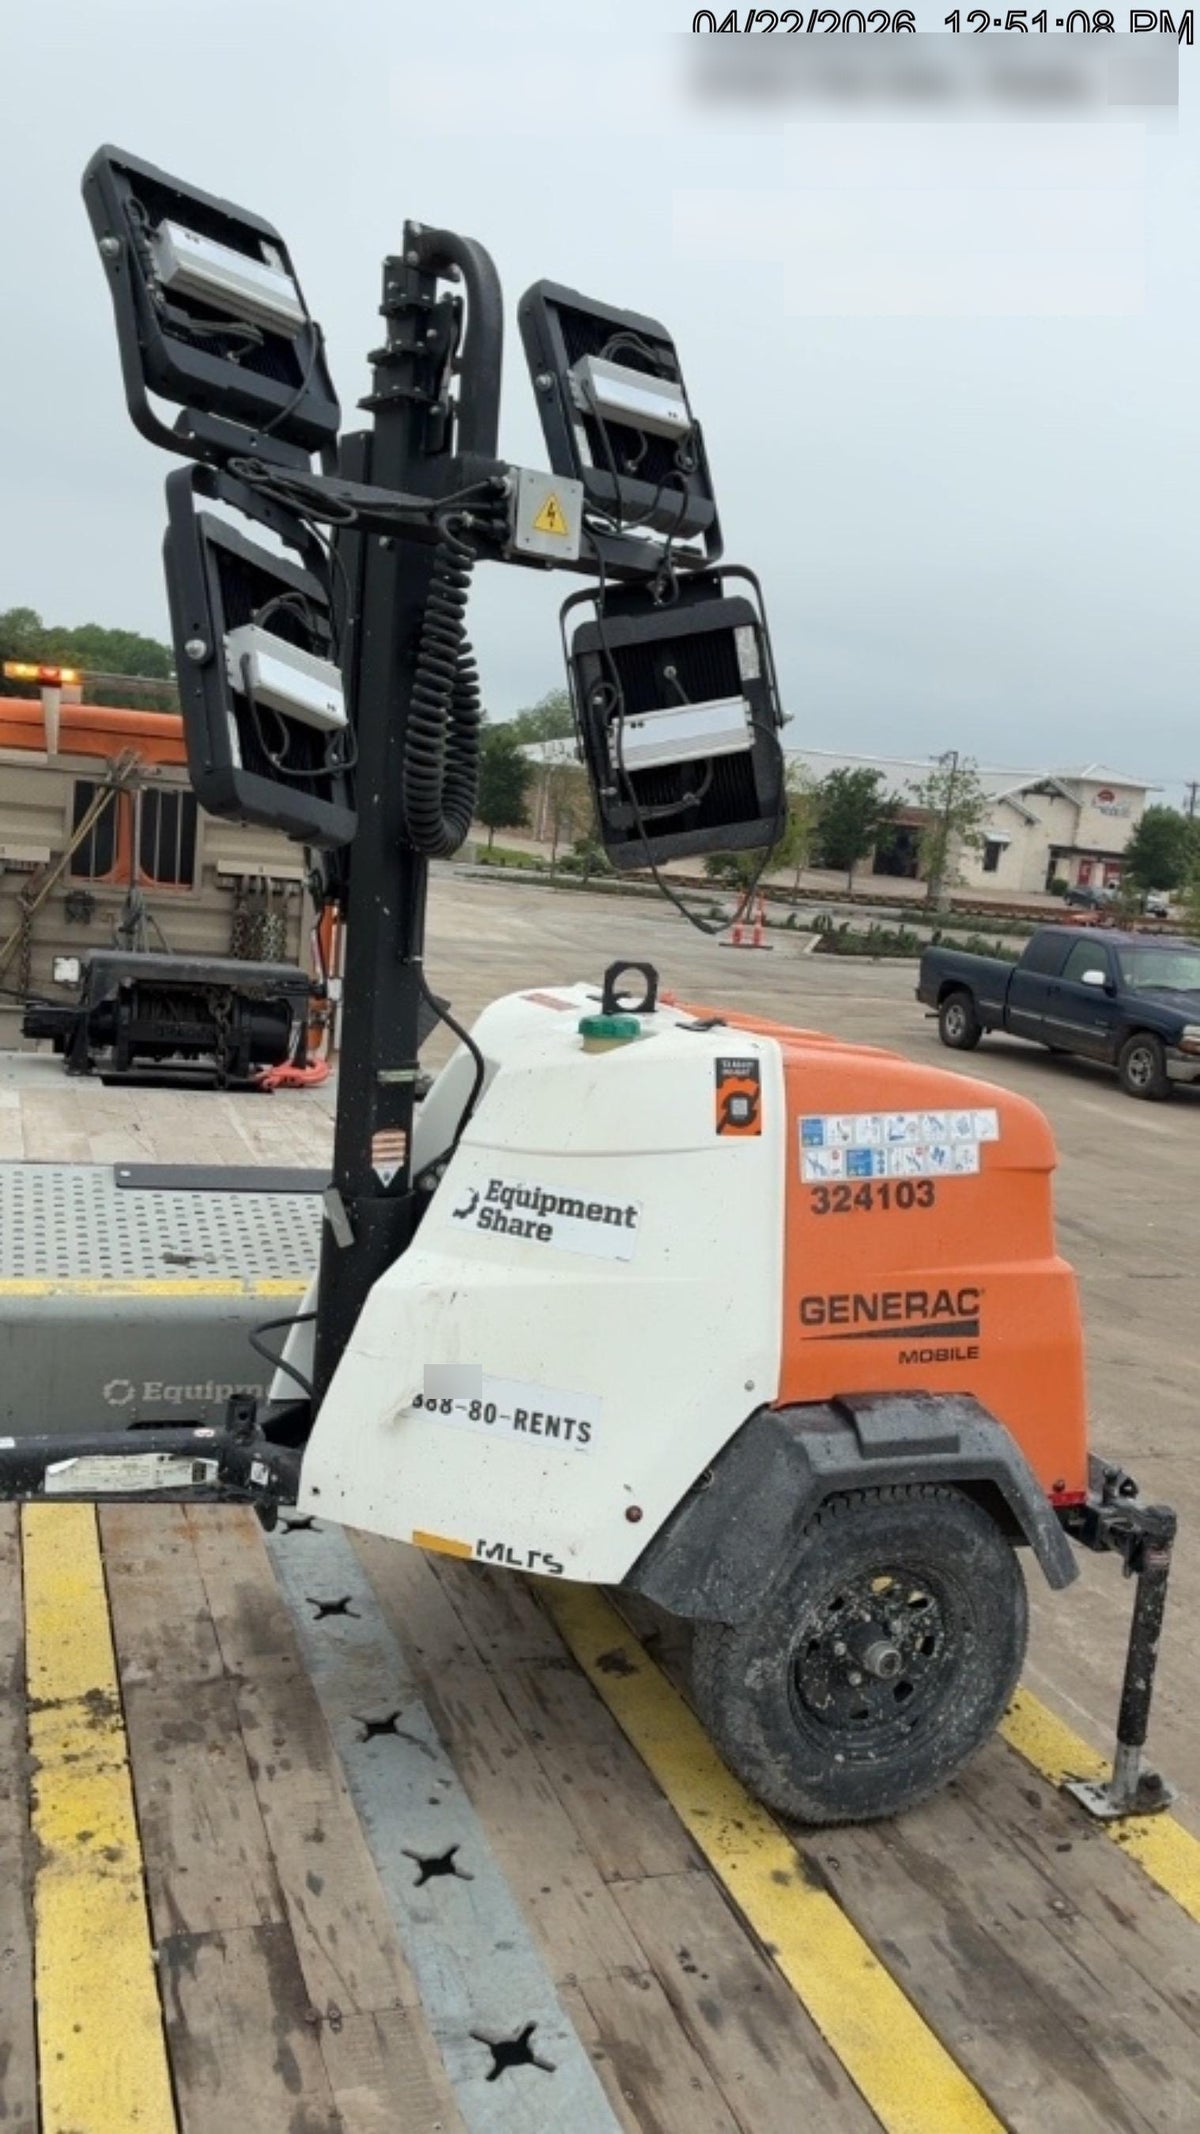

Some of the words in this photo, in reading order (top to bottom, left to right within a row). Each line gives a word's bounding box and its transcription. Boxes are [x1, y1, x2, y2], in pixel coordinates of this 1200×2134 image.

[484, 1178, 637, 1229] Equipment
[810, 1180, 935, 1215] 324103
[476, 1206, 554, 1242] Share
[800, 1287, 980, 1326] GENERAC
[897, 1346, 979, 1364] MOBILE
